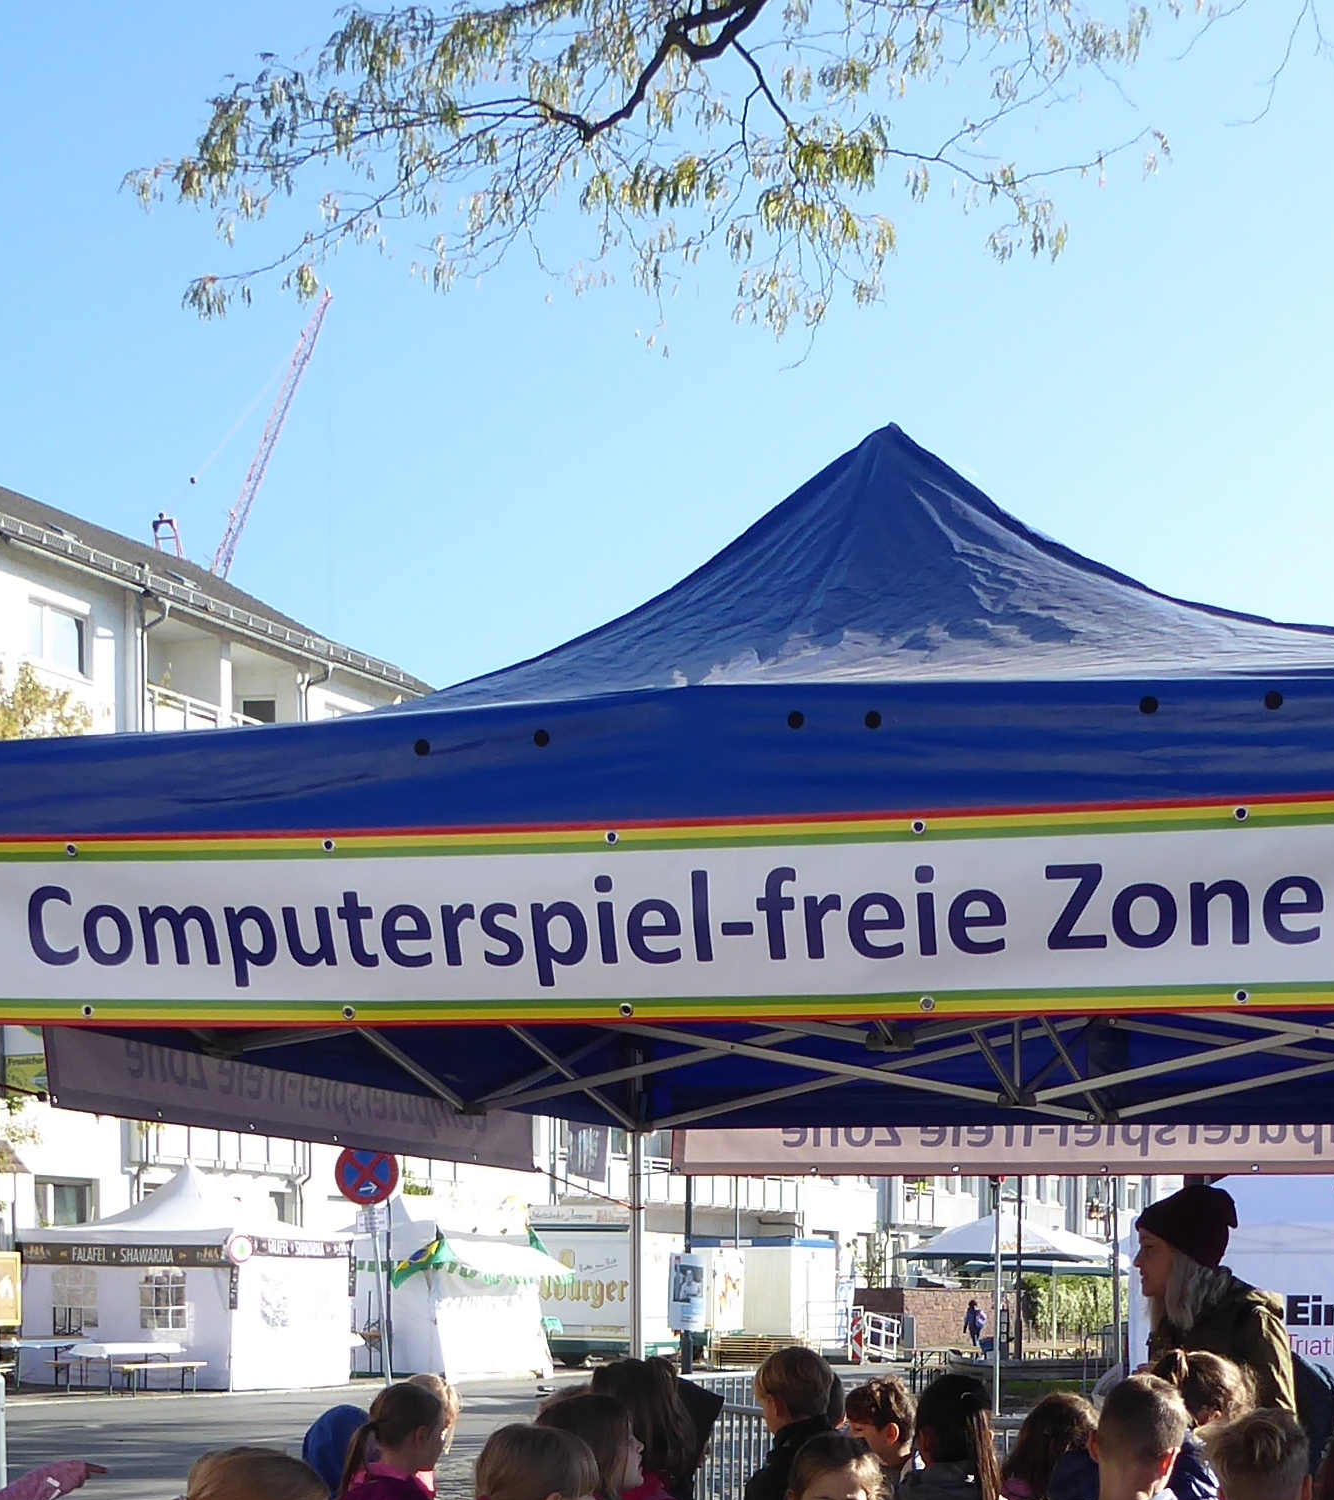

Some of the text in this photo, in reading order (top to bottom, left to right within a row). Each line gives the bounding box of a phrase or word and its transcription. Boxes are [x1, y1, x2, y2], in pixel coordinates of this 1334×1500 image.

[28, 863, 1324, 987] Computerspiel-freie Zone
[72, 1247, 174, 1263] FALAFEL SHAWARMA
